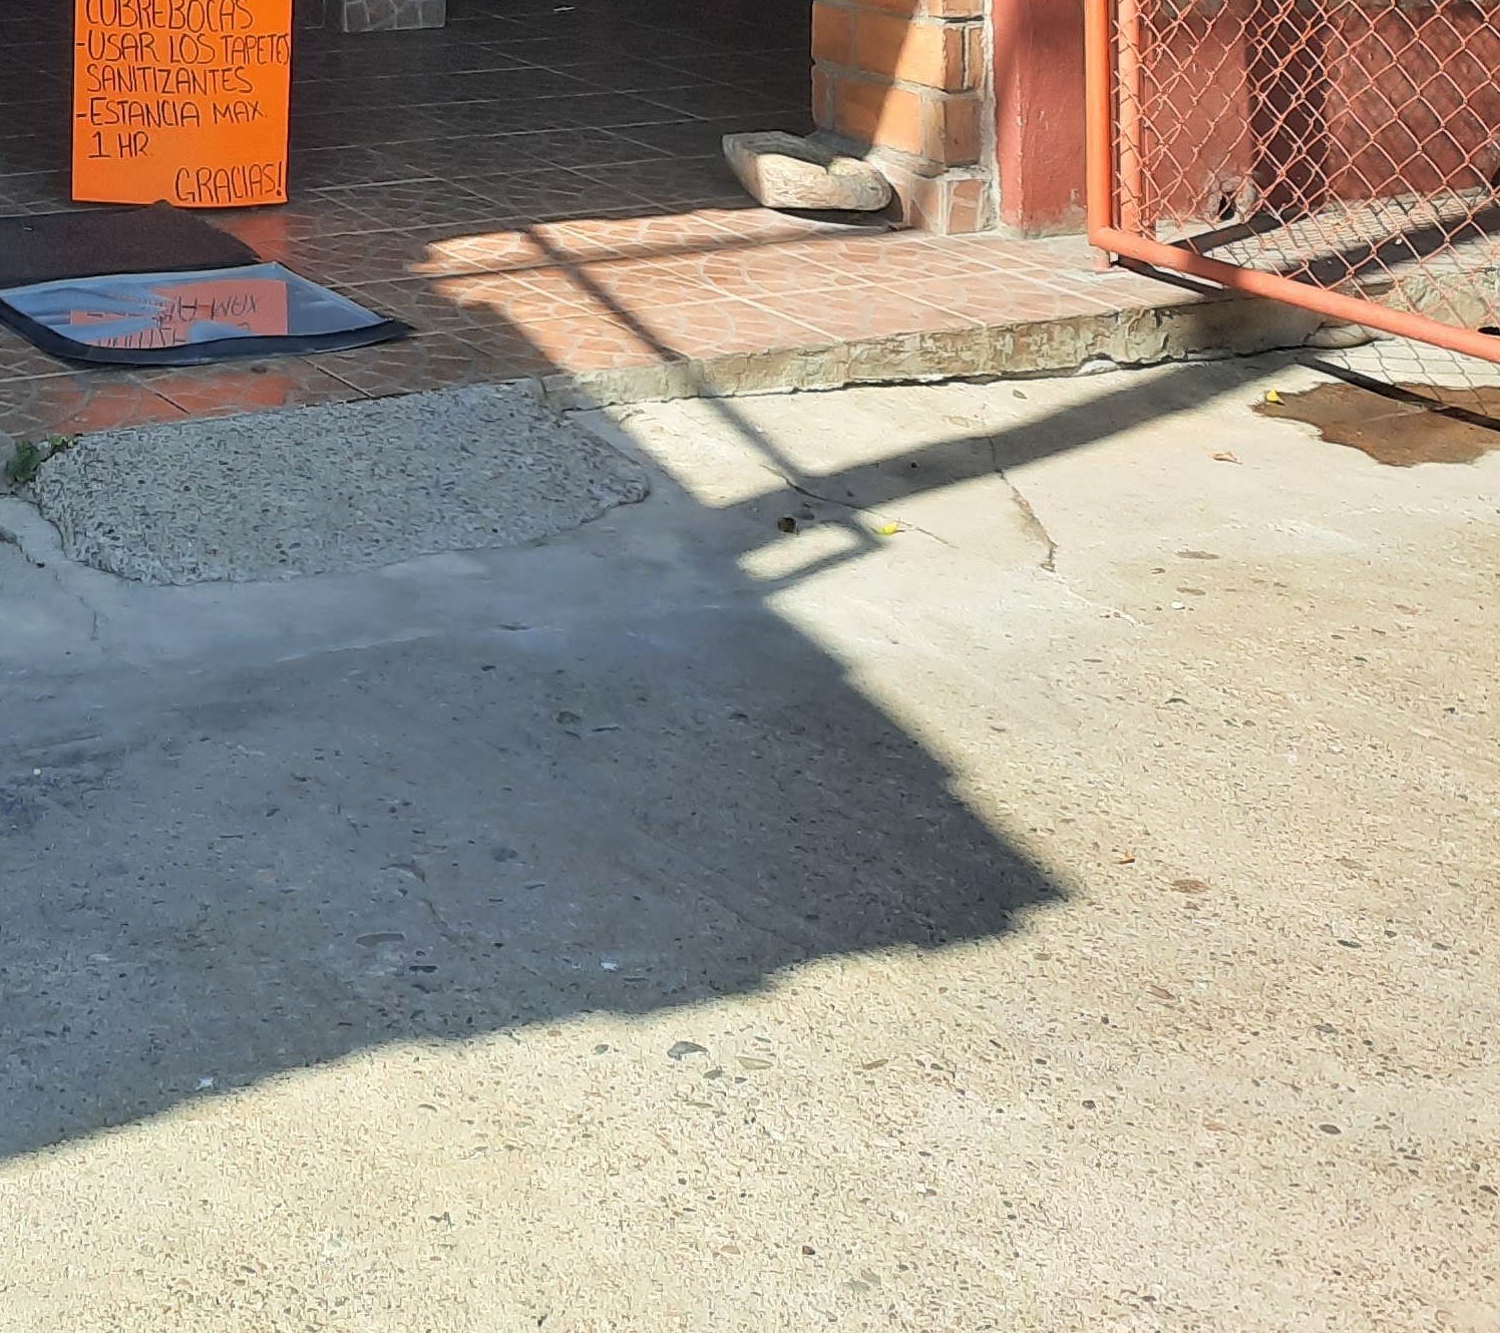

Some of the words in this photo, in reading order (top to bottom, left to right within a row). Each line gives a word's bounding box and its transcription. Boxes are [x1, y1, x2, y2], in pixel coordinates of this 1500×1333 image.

[169, 33, 216, 65] LOS
[220, 32, 290, 66] TAPETES
[86, 63, 253, 96] SANITIZANTES
[88, 131, 111, 158] 1
[175, 161, 283, 204] GRACIAS!
